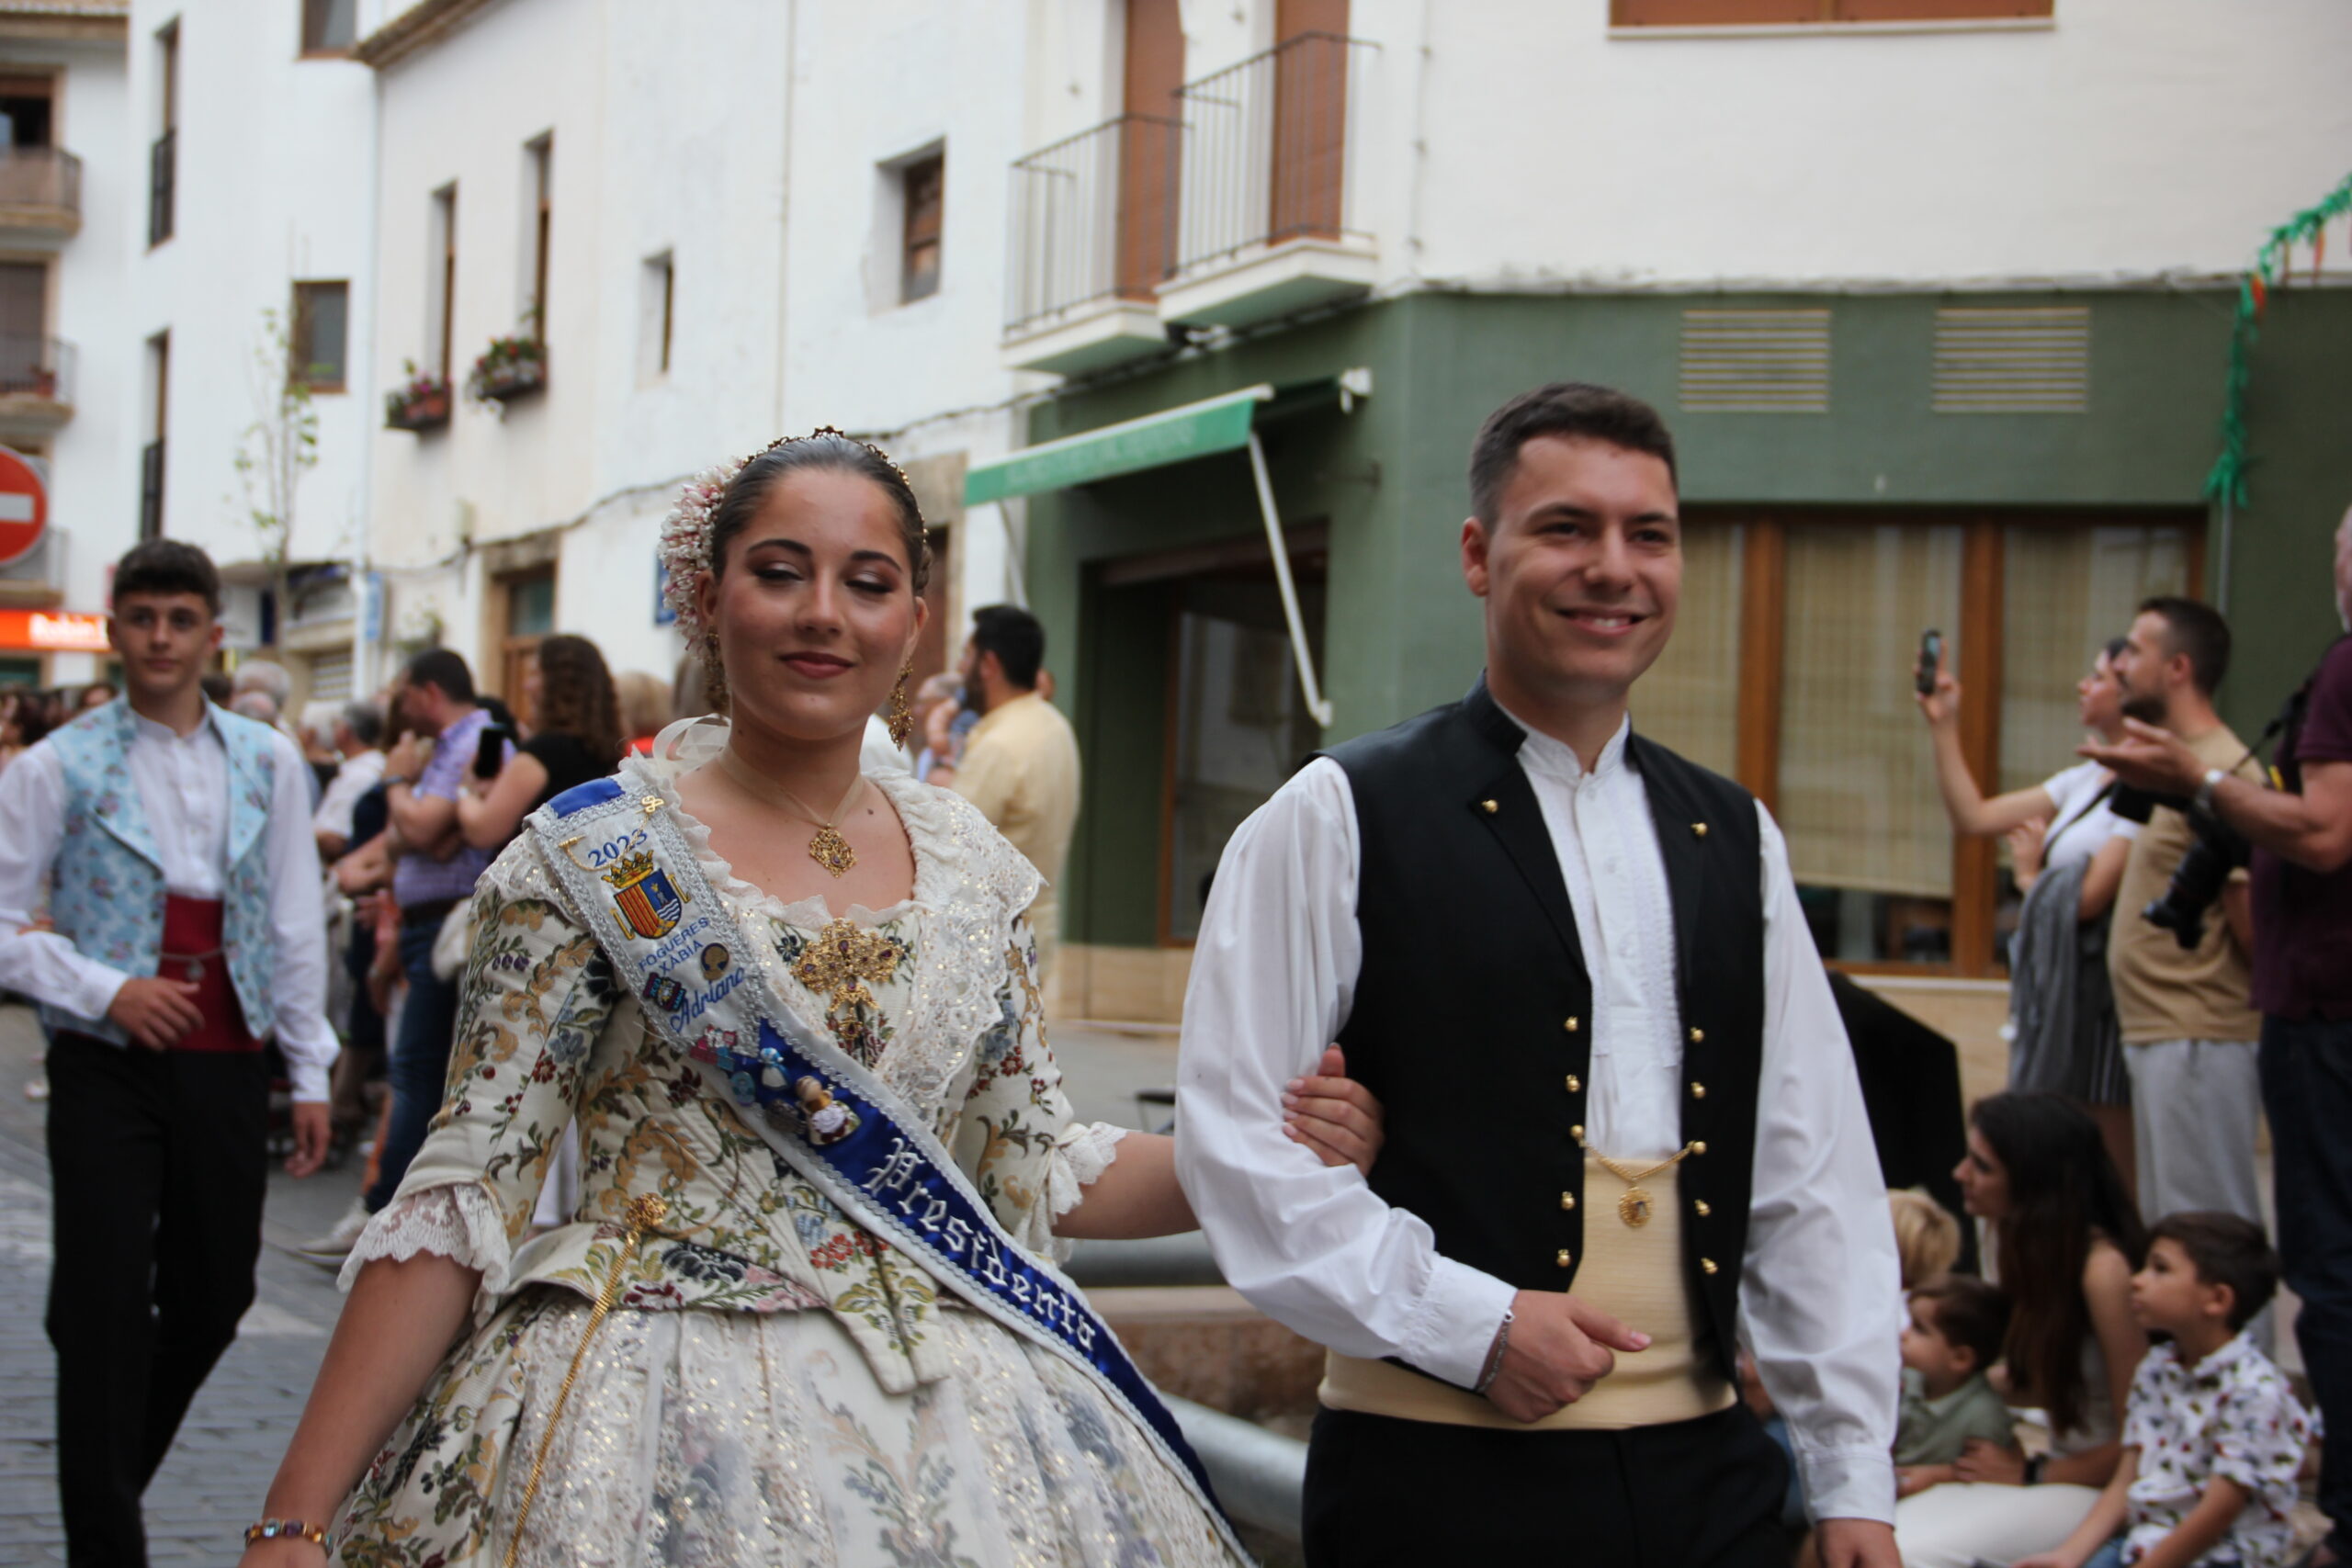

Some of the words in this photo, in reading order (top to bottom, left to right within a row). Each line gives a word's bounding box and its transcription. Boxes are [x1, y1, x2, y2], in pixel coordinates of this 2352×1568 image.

[588, 829, 648, 867] 2023
[638, 917, 710, 973] FOGUERES
[862, 1137, 1096, 1350] Presidenta
